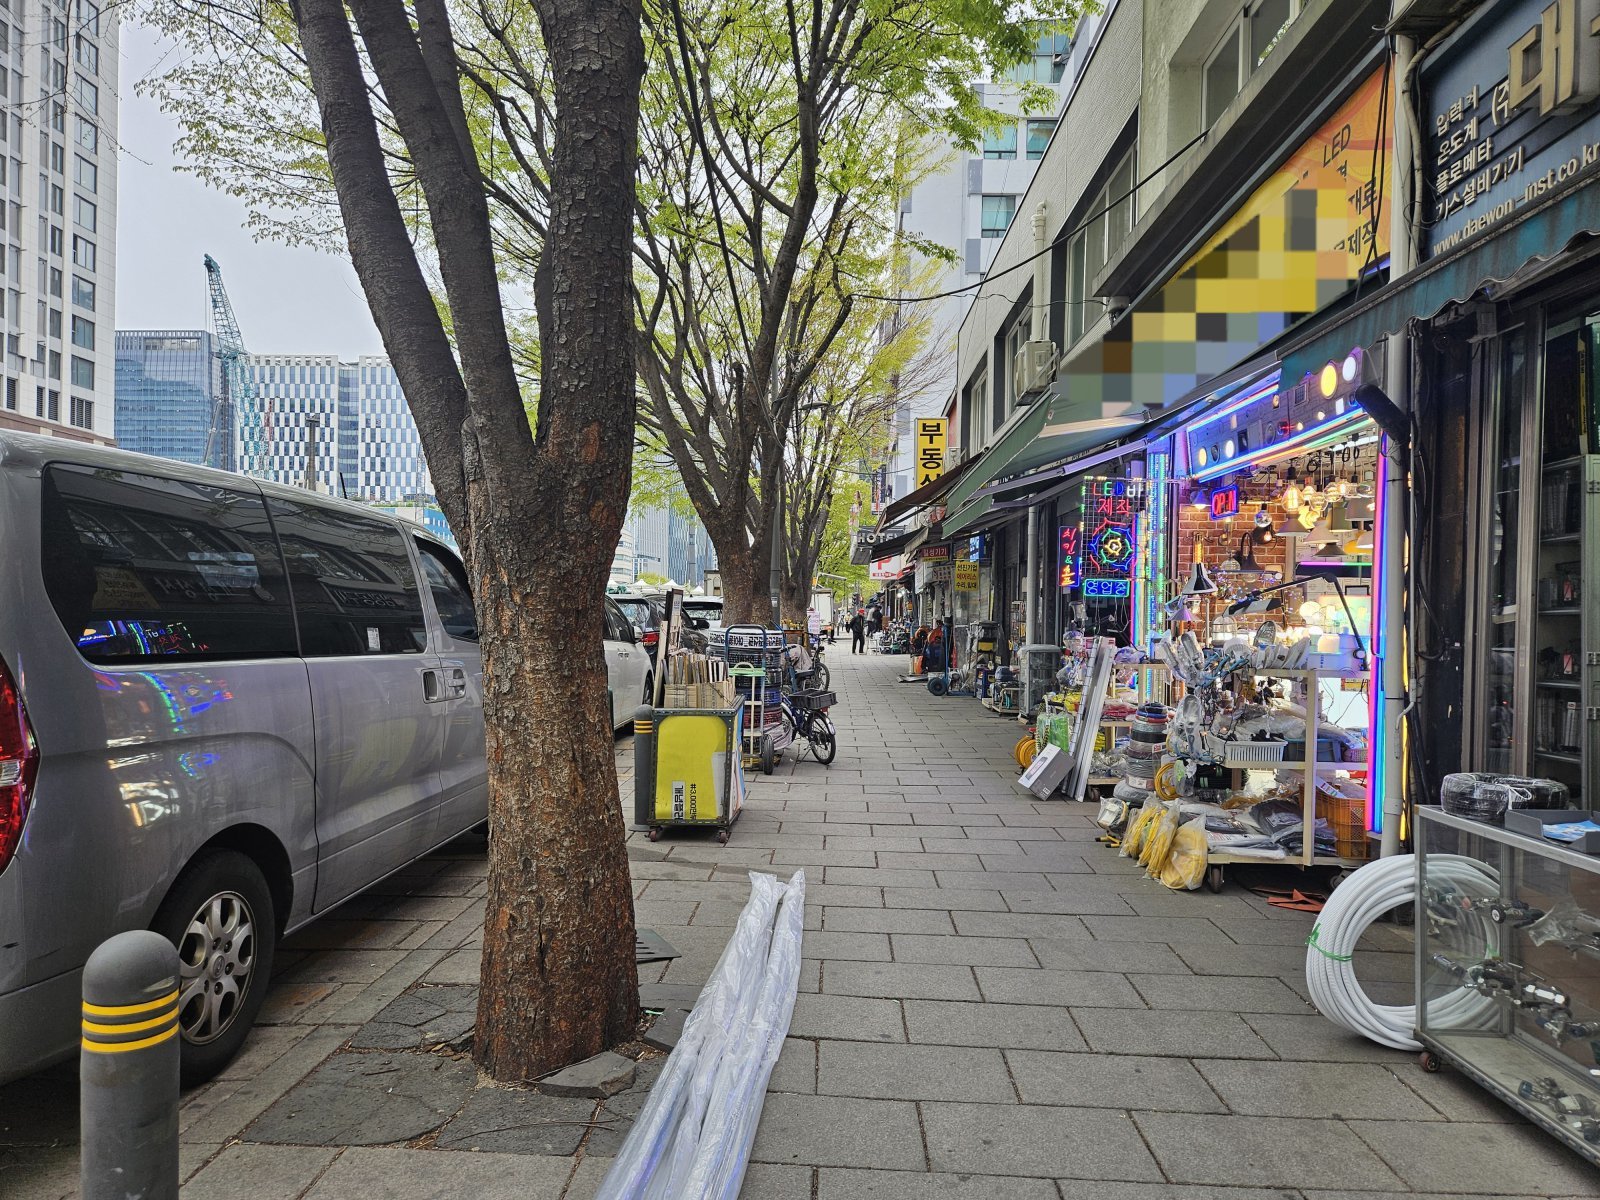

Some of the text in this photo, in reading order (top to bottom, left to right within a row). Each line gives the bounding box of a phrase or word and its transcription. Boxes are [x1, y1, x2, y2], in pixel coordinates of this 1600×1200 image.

[1323, 123, 1351, 168] LED
[1437, 116, 1479, 166] 온도계
[1435, 145, 1524, 221] 가스설비기기
[1436, 136, 1493, 194] 플로메타
[1093, 481, 1144, 498] LED바
[1098, 497, 1131, 517] 제작
[1087, 581, 1126, 595] 영업중
